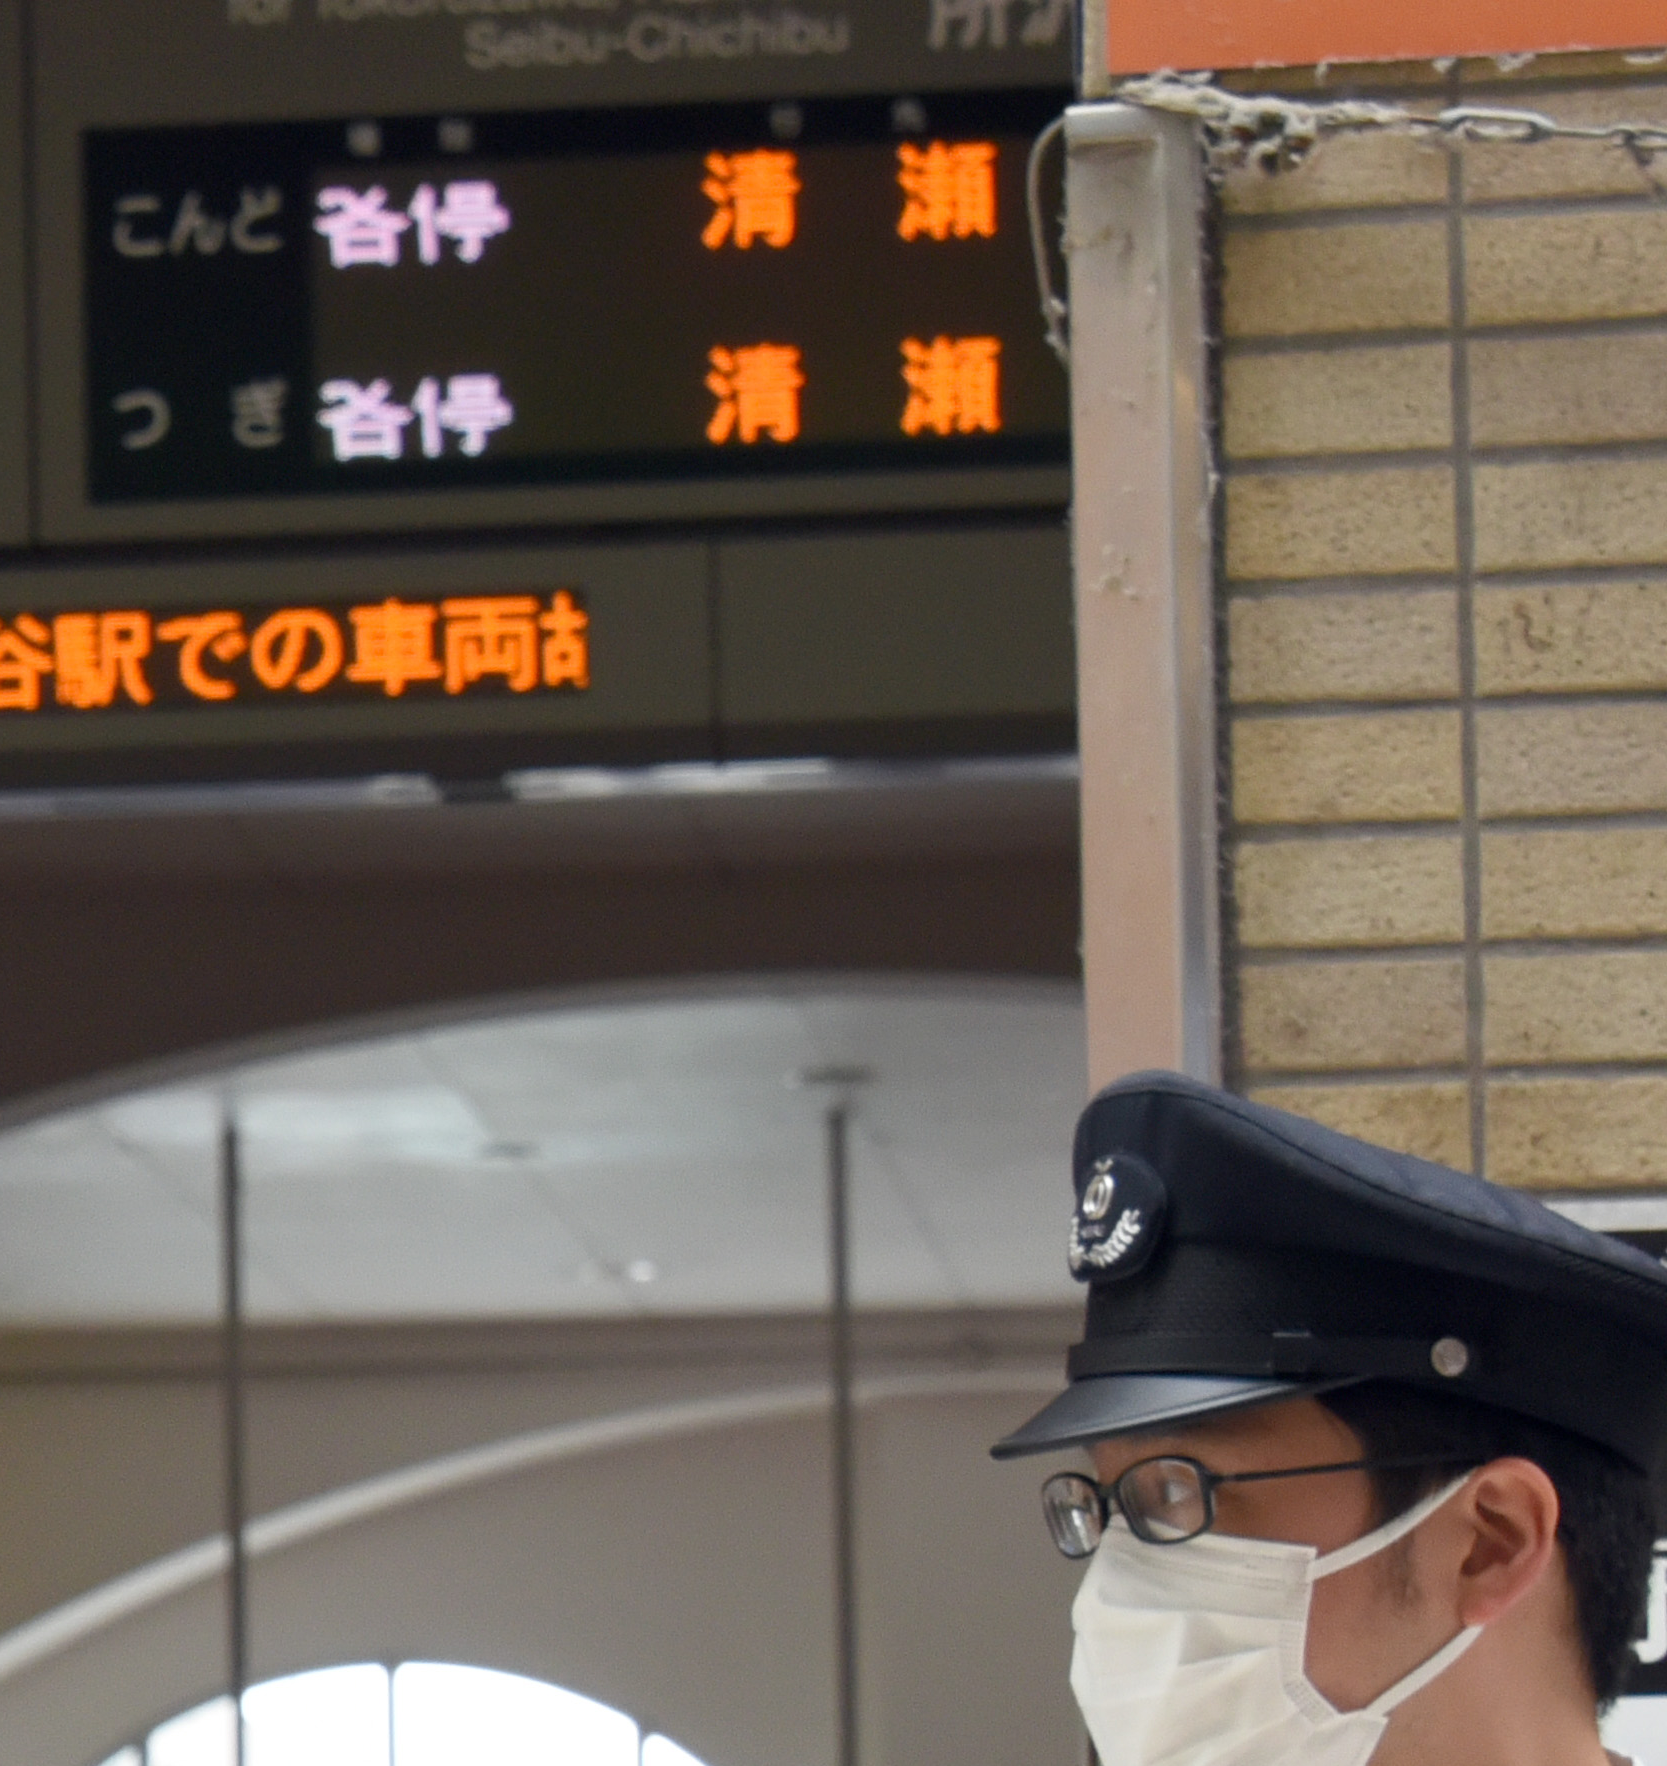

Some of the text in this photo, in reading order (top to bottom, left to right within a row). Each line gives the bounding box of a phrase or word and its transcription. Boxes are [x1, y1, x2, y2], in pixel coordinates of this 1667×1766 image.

[464, 12, 851, 71] Seibu-Chichibu
[112, 188, 283, 258] こんど
[314, 181, 511, 268] 各停
[115, 379, 286, 449] つぎ
[317, 374, 515, 462] 各停
